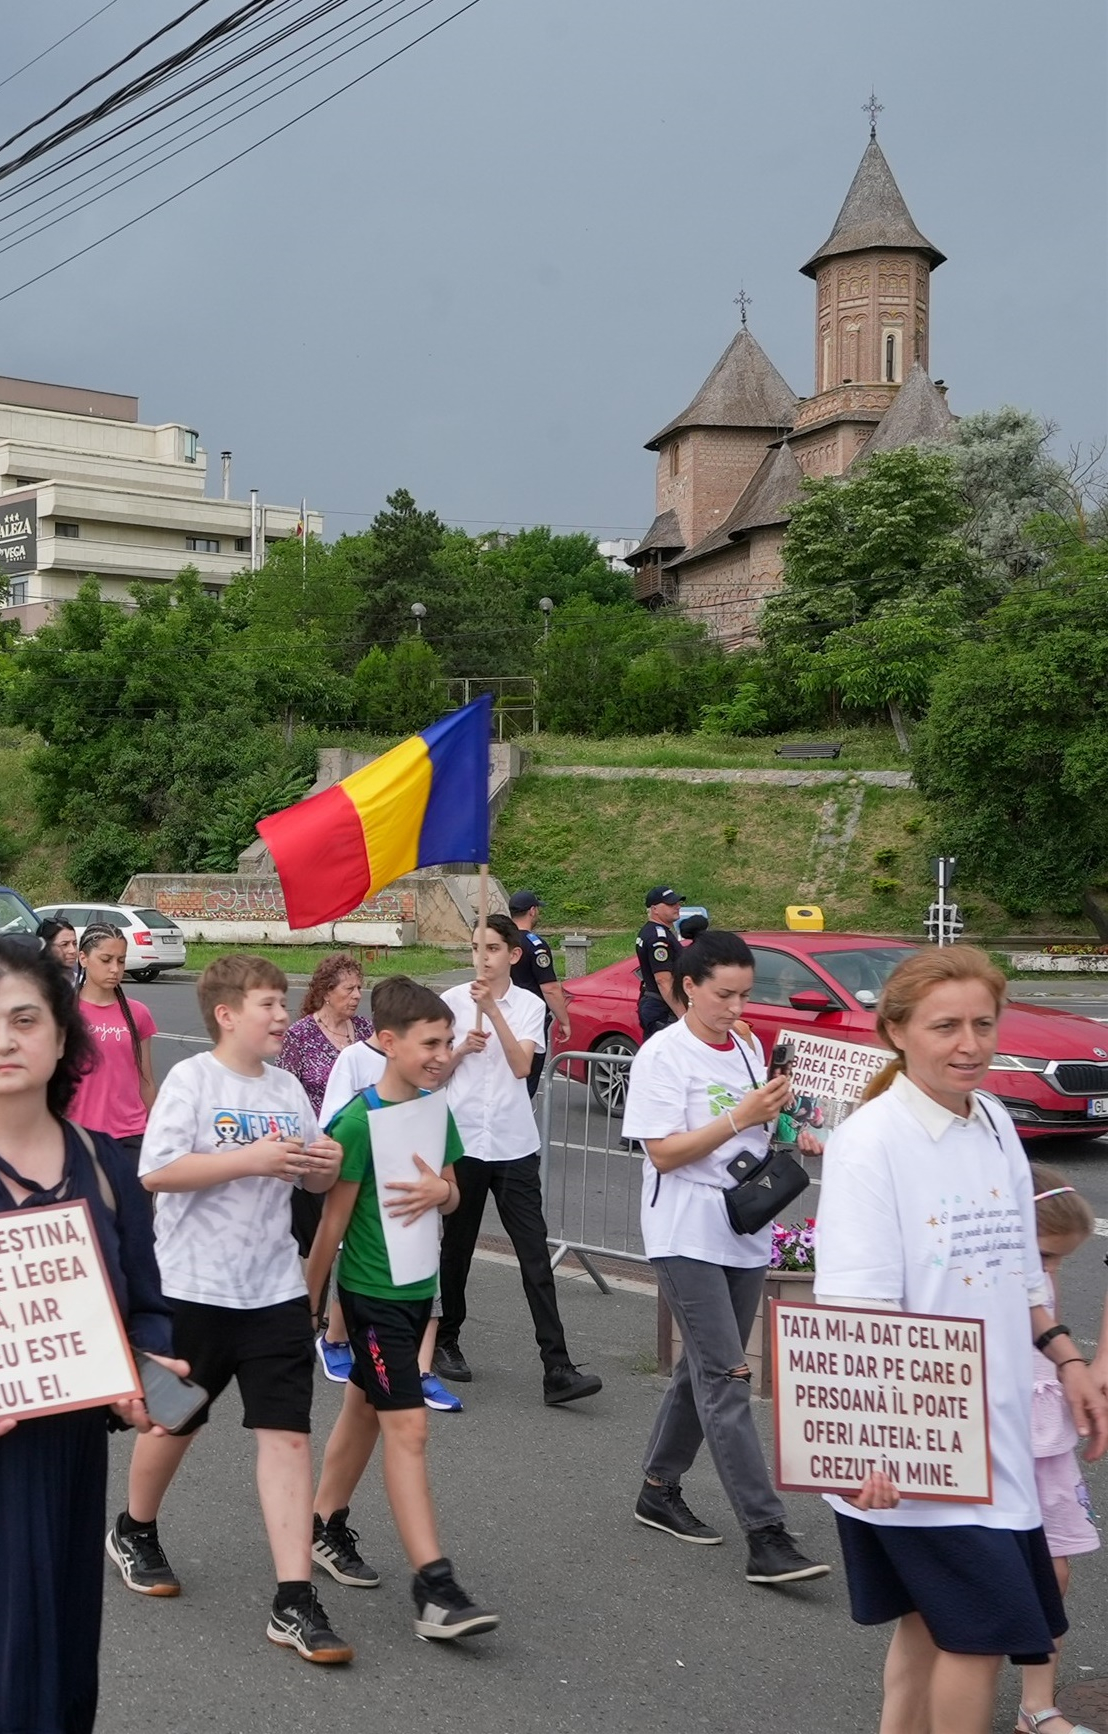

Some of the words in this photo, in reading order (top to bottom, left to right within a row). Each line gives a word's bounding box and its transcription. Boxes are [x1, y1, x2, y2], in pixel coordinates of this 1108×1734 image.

[3, 545, 26, 559] VEGA
[88, 1022, 129, 1041] enjoy
[792, 1055, 826, 1074] BIREA
[830, 1064, 861, 1082] ESTE
[797, 1040, 846, 1062] FAMILIA
[850, 1051, 892, 1074] CREȘ
[12, 1255, 88, 1290] LEGEA
[20, 1297, 63, 1327] IAR
[25, 1331, 87, 1363] ESTE
[780, 1314, 820, 1340] TATA
[825, 1318, 866, 1344] MI-A
[871, 1322, 903, 1347] DAT
[908, 1325, 939, 1350] CEL
[944, 1328, 978, 1353] MAI
[789, 1349, 838, 1375] MARE
[844, 1354, 878, 1379] DAR
[883, 1357, 905, 1381] PE
[910, 1359, 956, 1384] CARE
[961, 1363, 972, 1386] O
[37, 1374, 71, 1401] EI.
[795, 1384, 888, 1414] PERSOANĂ
[891, 1385, 908, 1415] ÎL
[913, 1393, 969, 1420] POATE
[804, 1419, 853, 1445] OFERI
[858, 1423, 922, 1450] ALTEIA:
[926, 1428, 947, 1452] EL
[951, 1430, 963, 1453] A
[810, 1455, 876, 1481] CREZUT
[880, 1453, 900, 1484] ÎN
[906, 1461, 959, 1488] MINE.
